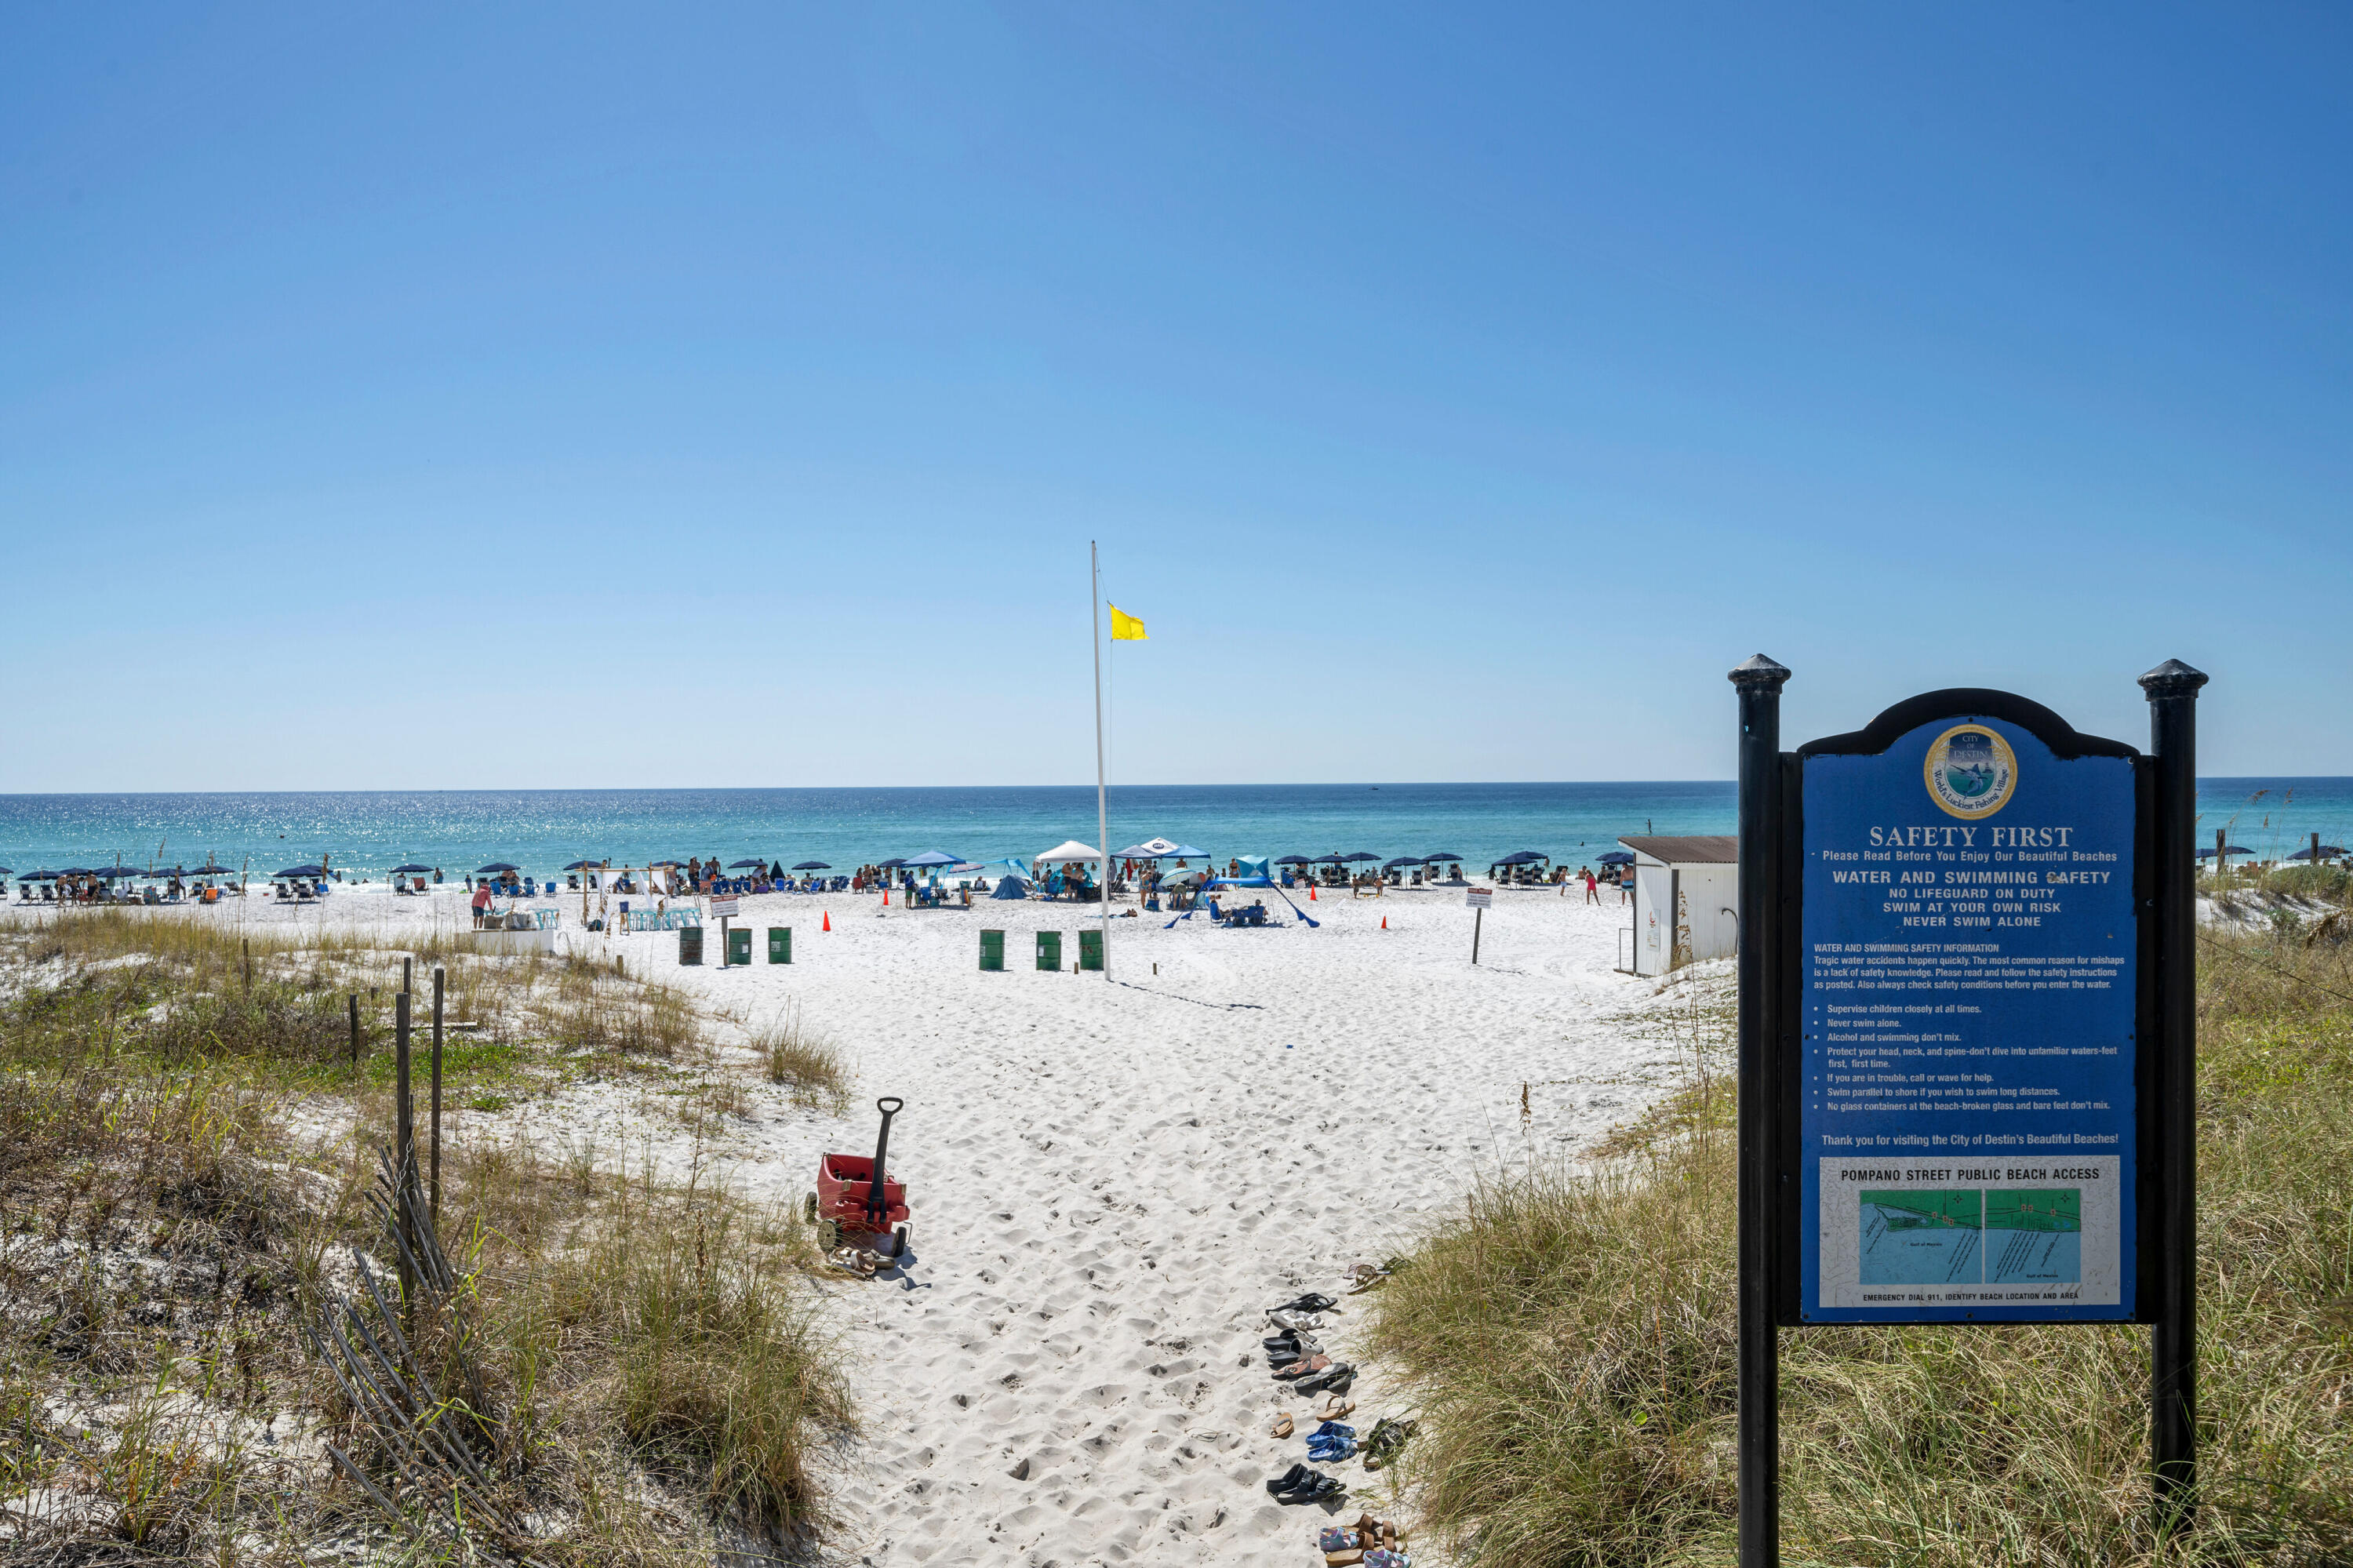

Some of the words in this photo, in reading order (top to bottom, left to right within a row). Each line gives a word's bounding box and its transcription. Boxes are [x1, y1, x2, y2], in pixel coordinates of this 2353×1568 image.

[1934, 769, 1947, 796] World's
[1946, 794, 1973, 809] Luckiest
[1975, 792, 2000, 809] Fishing
[1995, 769, 2009, 791] Village
[1870, 827, 1977, 846] SAFETY
[1991, 827, 2073, 847] FIRST
[1823, 850, 1859, 860] Please
[1864, 850, 1890, 860] Read
[1897, 850, 1931, 861] Before
[1937, 851, 1955, 861] You
[1961, 851, 1989, 863] Enjoy
[1995, 851, 2013, 861] Our
[2019, 851, 2067, 861] Beautiful
[2072, 851, 2117, 861] Beaches
[1832, 871, 1890, 883] WATER
[1900, 871, 1935, 883] AND
[1945, 871, 2038, 883] SWIMMING
[2046, 871, 2110, 883] SAFETY
[1889, 888, 1907, 898] NO
[1915, 889, 1988, 898] LIFEGUARD
[1995, 889, 2013, 898] ON
[2020, 889, 2055, 899] DUTY
[1883, 902, 1920, 912] SWIM
[1927, 902, 1945, 912] AT
[1949, 902, 1985, 912] YOUR
[1992, 903, 2023, 912] OWN
[2030, 903, 2061, 912] RISK
[1904, 916, 1946, 926] NEVER
[1953, 916, 1991, 926] SWIM
[1997, 917, 2041, 926] ALONE
[1813, 944, 1842, 952] WATER
[1845, 944, 1862, 952] AND
[1864, 944, 1909, 952] SWIMMING
[1911, 944, 1941, 952] SAFETY
[1944, 944, 1999, 952] INFORMATION
[1813, 955, 1838, 966] Tragic
[1867, 955, 1906, 965] accidents
[1907, 956, 1937, 966] happen
[1940, 956, 1970, 966] quickly.
[1973, 956, 1988, 965] The
[1989, 956, 2009, 965] most
[2077, 955, 2089, 964] for
[2090, 955, 2125, 966] mishaps
[1814, 968, 1821, 977] is
[1831, 968, 1848, 977] lack
[1849, 968, 1859, 977] of
[1860, 968, 1886, 978] safety
[1887, 968, 1933, 978] knowledge.
[1936, 968, 1962, 977] Please
[1964, 968, 1982, 977] read
[1984, 968, 1999, 977] and
[2002, 968, 2026, 977] follow
[2028, 968, 2041, 977] the
[2043, 968, 2068, 978] safety
[2069, 968, 2117, 977] instructions
[1826, 980, 1856, 991] posted.
[1857, 980, 1875, 989] Also
[1877, 980, 1906, 990] always
[1907, 980, 1933, 988] check
[1934, 980, 1958, 990] safety
[1827, 1004, 1867, 1015] Supervise
[1870, 1004, 1903, 1013] children
[1904, 1005, 1933, 1015] closely
[1945, 1004, 1955, 1013] all
[1957, 1004, 1981, 1013] times.
[1827, 1018, 1851, 1028] Never
[1853, 1018, 1875, 1028] swim
[1877, 1018, 1901, 1028] alone.
[1827, 1032, 1857, 1042] Alcohol
[1860, 1033, 1875, 1042] and
[1877, 1033, 1919, 1043] swimming
[1922, 1033, 1942, 1042] don't
[1827, 1046, 1857, 1056] Protect
[1858, 1049, 1877, 1057] your
[1878, 1047, 1901, 1057] head,
[1903, 1047, 1925, 1057] neck,
[1926, 1047, 1942, 1056] and
[1992, 1046, 2009, 1055] dive
[2011, 1046, 2027, 1055] into
[2028, 1046, 2069, 1055] unfamiliar
[1828, 1059, 1847, 1068] first,
[1851, 1059, 1868, 1068] first
[1870, 1059, 1890, 1068] time.
[1827, 1087, 1850, 1097] Swim
[1852, 1087, 1882, 1098] parallel
[1885, 1088, 1893, 1097] to
[1895, 1088, 1918, 1097] shore
[1920, 1087, 1926, 1096] if
[1928, 1090, 1942, 1098] you
[1944, 1087, 1964, 1096] wish
[1976, 1087, 1998, 1096] swim
[2000, 1087, 2017, 1097] long
[1827, 1101, 1838, 1111] No
[1840, 1101, 1862, 1112] glass
[1864, 1101, 1907, 1111] containers
[1909, 1102, 1918, 1111] at
[1919, 1101, 1933, 1111] the
[1934, 1101, 1991, 1110] beach-broken
[1992, 1101, 2014, 1111] glass
[2093, 1101, 2110, 1109] mix.
[1821, 1134, 1853, 1145] Thank
[1856, 1137, 1873, 1148] you
[1876, 1134, 1890, 1145] for
[1893, 1134, 1929, 1147] visiting
[1932, 1134, 1948, 1145] the
[1951, 1134, 1969, 1147] City
[1972, 1134, 1982, 1144] of
[1985, 1134, 2024, 1144] Destin's
[2027, 1133, 2071, 1144] Beautiful
[2074, 1133, 2118, 1144] Beaches!
[1842, 1170, 1900, 1181] POMPANO
[1907, 1170, 1951, 1181] STREET
[1958, 1169, 2000, 1180] PUBLIC
[2007, 1169, 2046, 1180] BEACH
[2053, 1168, 2100, 1180] ACCESS
